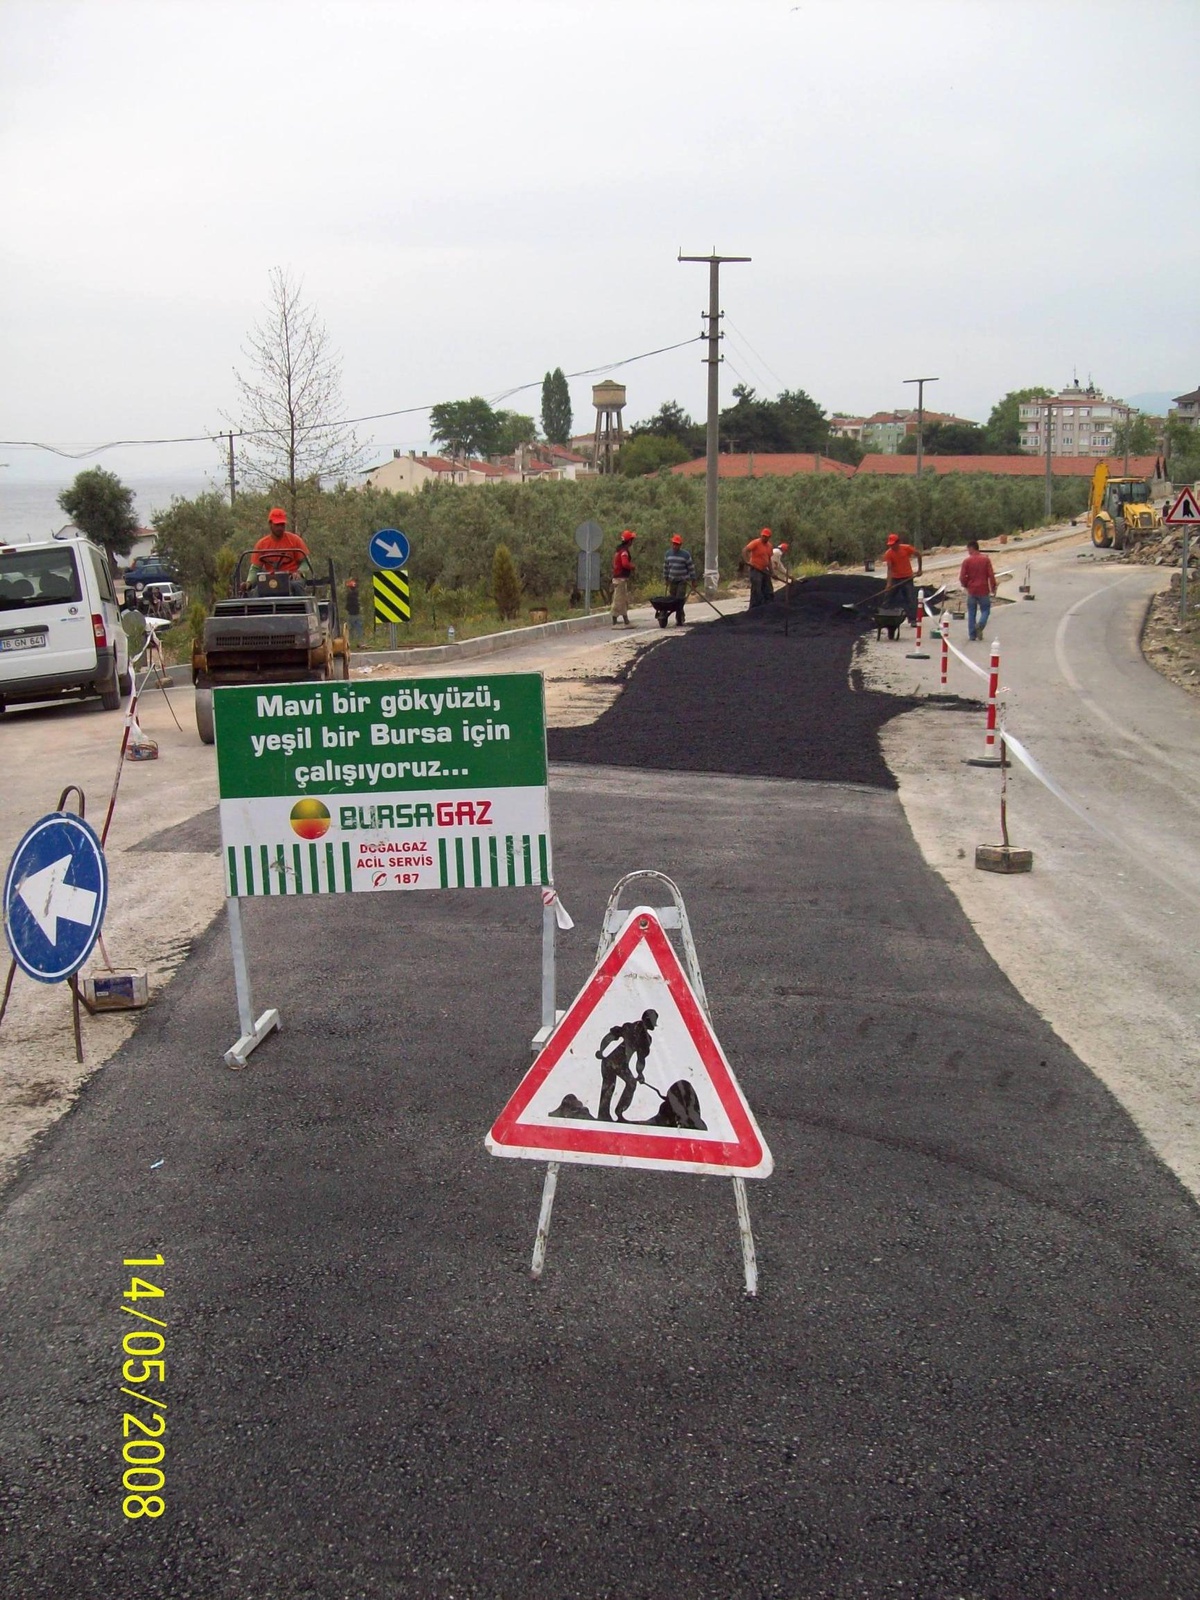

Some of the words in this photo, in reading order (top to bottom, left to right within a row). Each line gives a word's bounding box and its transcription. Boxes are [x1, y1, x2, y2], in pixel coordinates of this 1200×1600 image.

[257, 693, 321, 717] Mavi
[333, 690, 370, 714] bir
[381, 686, 501, 718] gökyüzü,
[251, 727, 311, 756] yeşil
[322, 724, 360, 748] bir
[371, 723, 452, 746] Bursa
[463, 719, 510, 747] için
[295, 760, 469, 788] çalışıyoruz...
[339, 801, 493, 830] BURSAGAZ
[357, 855, 385, 868] ACİL
[388, 854, 433, 867] SERVİS
[360, 841, 428, 853] DOĞALGAZ
[394, 873, 419, 884] 187
